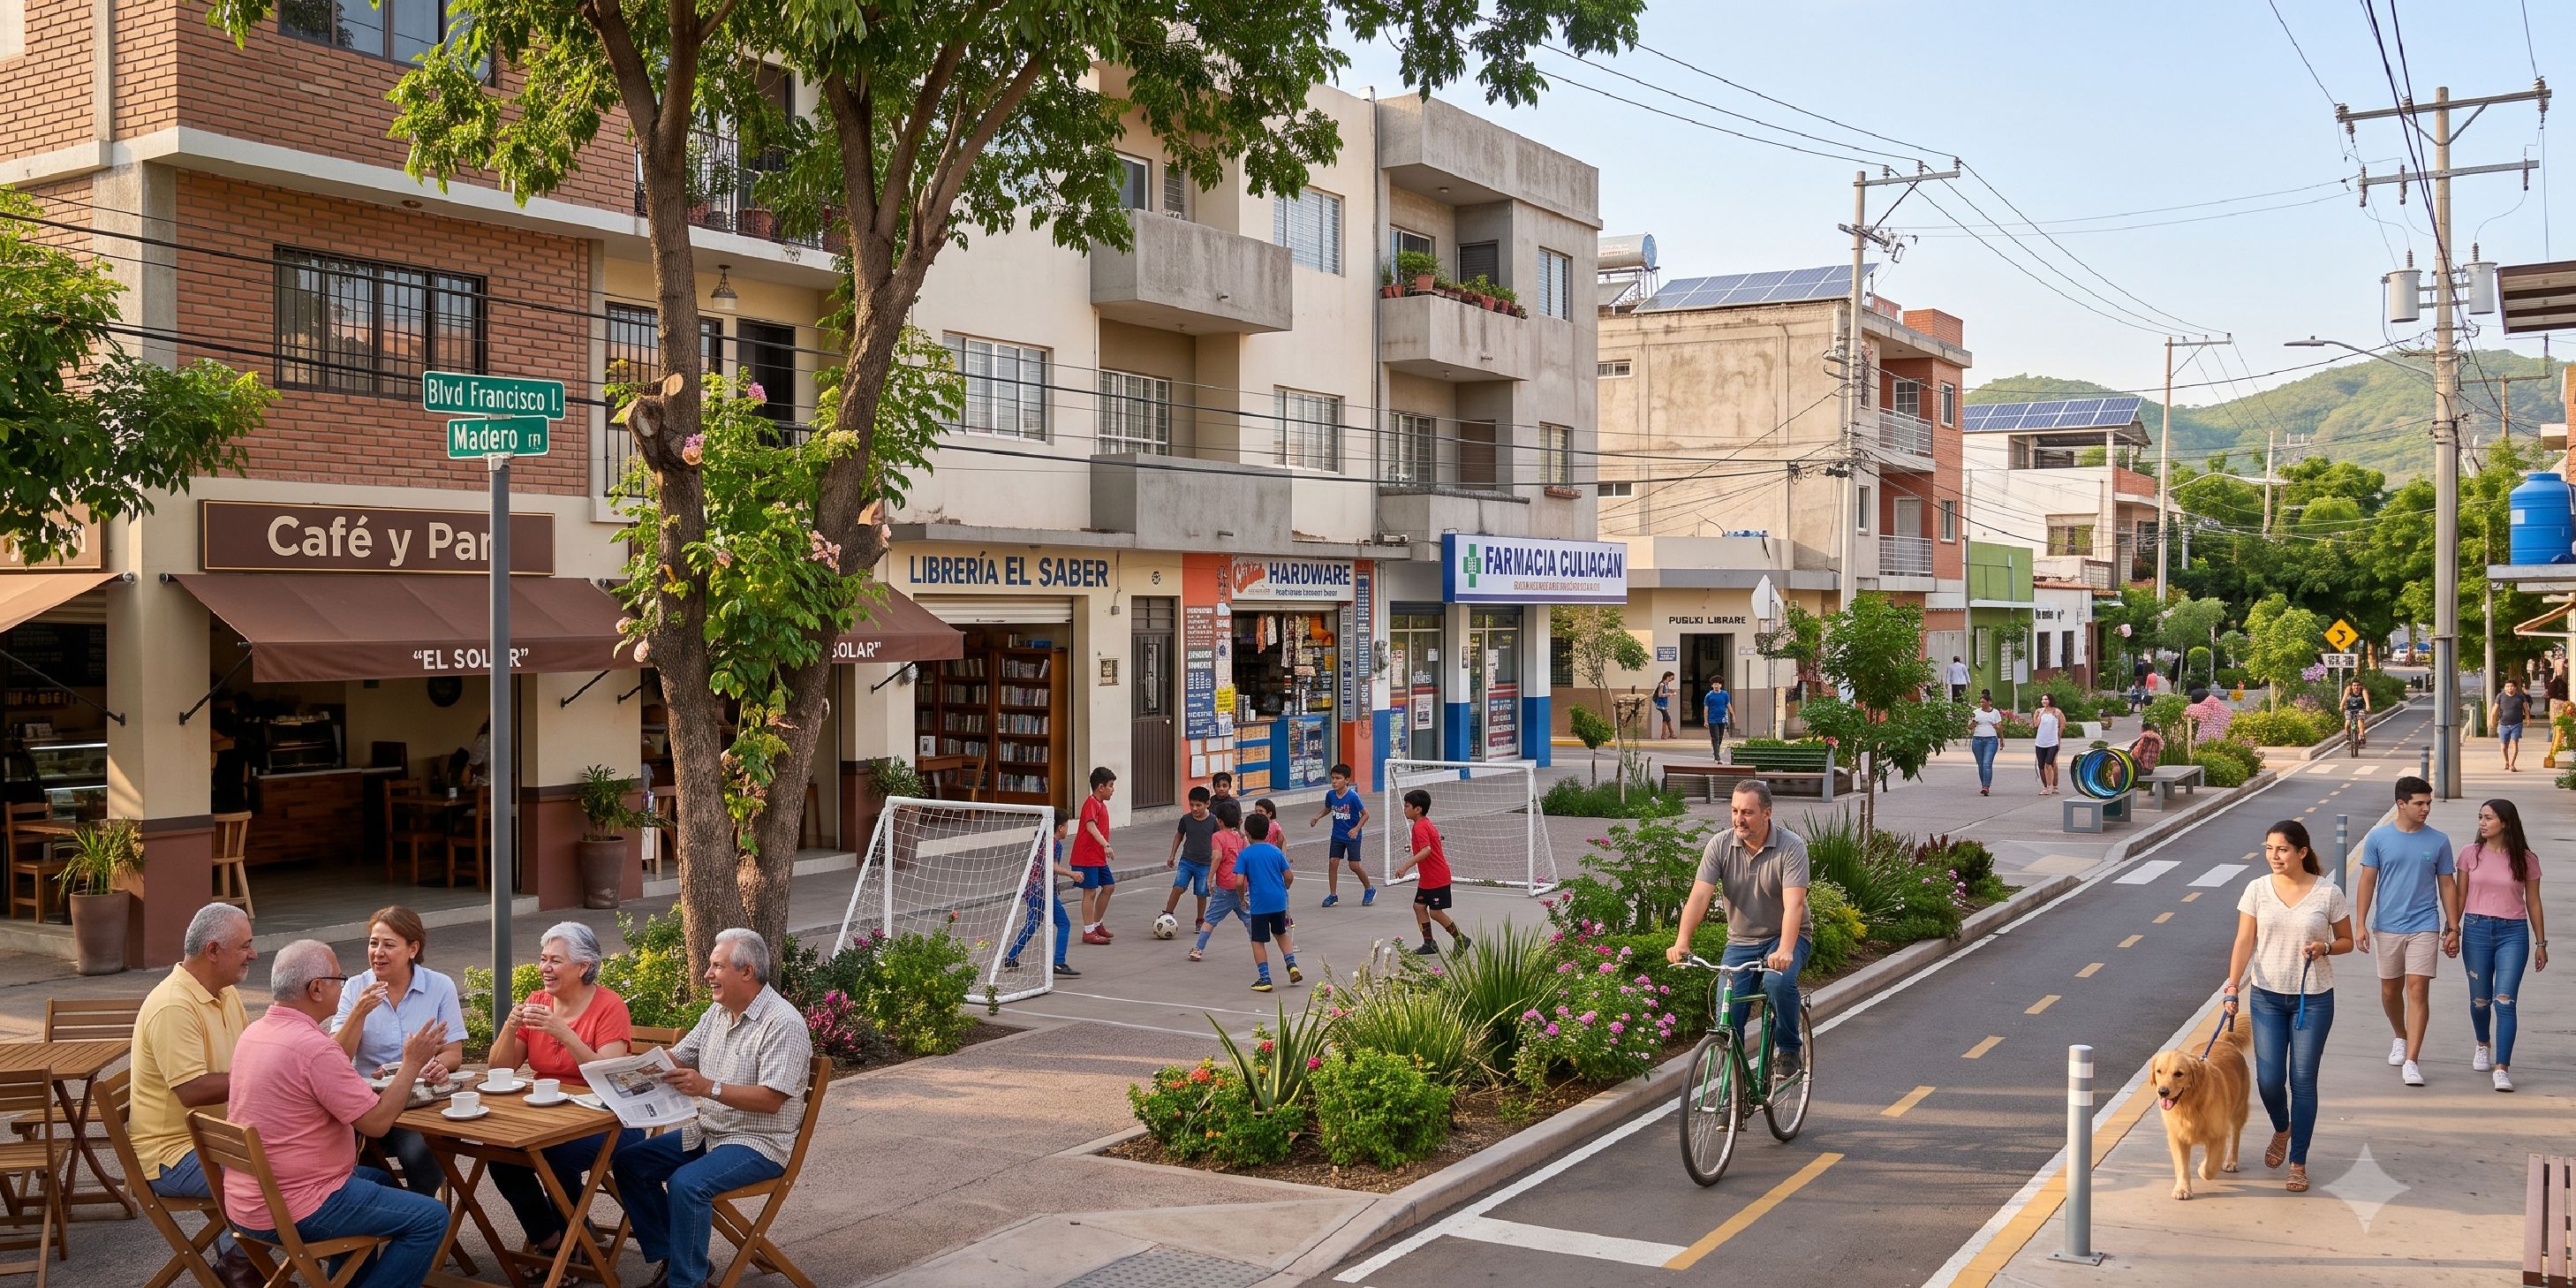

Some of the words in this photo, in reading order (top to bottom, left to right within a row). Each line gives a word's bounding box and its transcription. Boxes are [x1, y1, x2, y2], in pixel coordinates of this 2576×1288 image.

[428, 378, 464, 406] Blvd
[471, 381, 545, 411] Francisco
[454, 424, 518, 451] Madero
[268, 514, 373, 558] Café
[387, 528, 412, 567] y
[910, 550, 1000, 585] LIBRERÍA
[1005, 556, 1031, 586] EL
[1039, 557, 1109, 587] SABER
[1269, 562, 1351, 586] HARDWARE
[1485, 546, 1557, 577] FARMACIA
[1560, 546, 1622, 579] CULIACÁN
[454, 648, 529, 669] SOLR”
